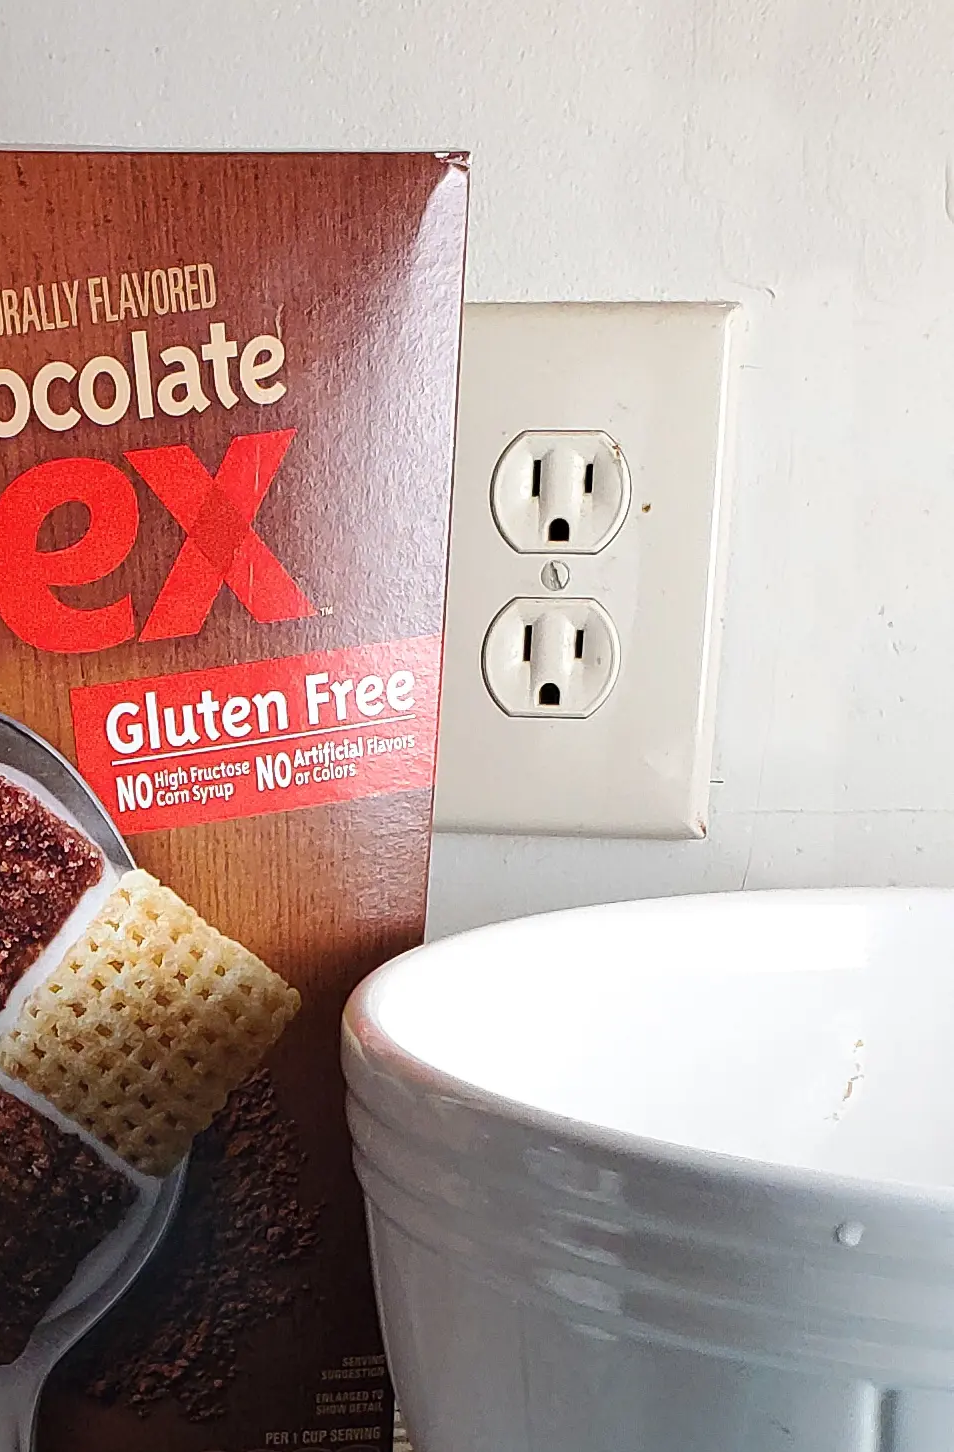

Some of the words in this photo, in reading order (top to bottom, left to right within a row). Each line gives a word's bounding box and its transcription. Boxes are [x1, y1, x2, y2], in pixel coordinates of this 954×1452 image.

[89, 261, 217, 324] FLAVORED
[105, 689, 290, 755] Gluten
[305, 670, 417, 726] Free
[115, 772, 153, 813] NO
[153, 769, 189, 790] High
[190, 759, 251, 783] Fructose
[254, 753, 292, 792] NO
[293, 736, 365, 769] Artificial
[366, 732, 416, 757] Flavors
[294, 770, 312, 787] or
[312, 761, 357, 782] Colors
[155, 786, 191, 808] Corn
[192, 782, 235, 805] Syrup
[265, 1431, 289, 1445] PER
[302, 1429, 327, 1444] CUP
[330, 1426, 381, 1443] SERVING
